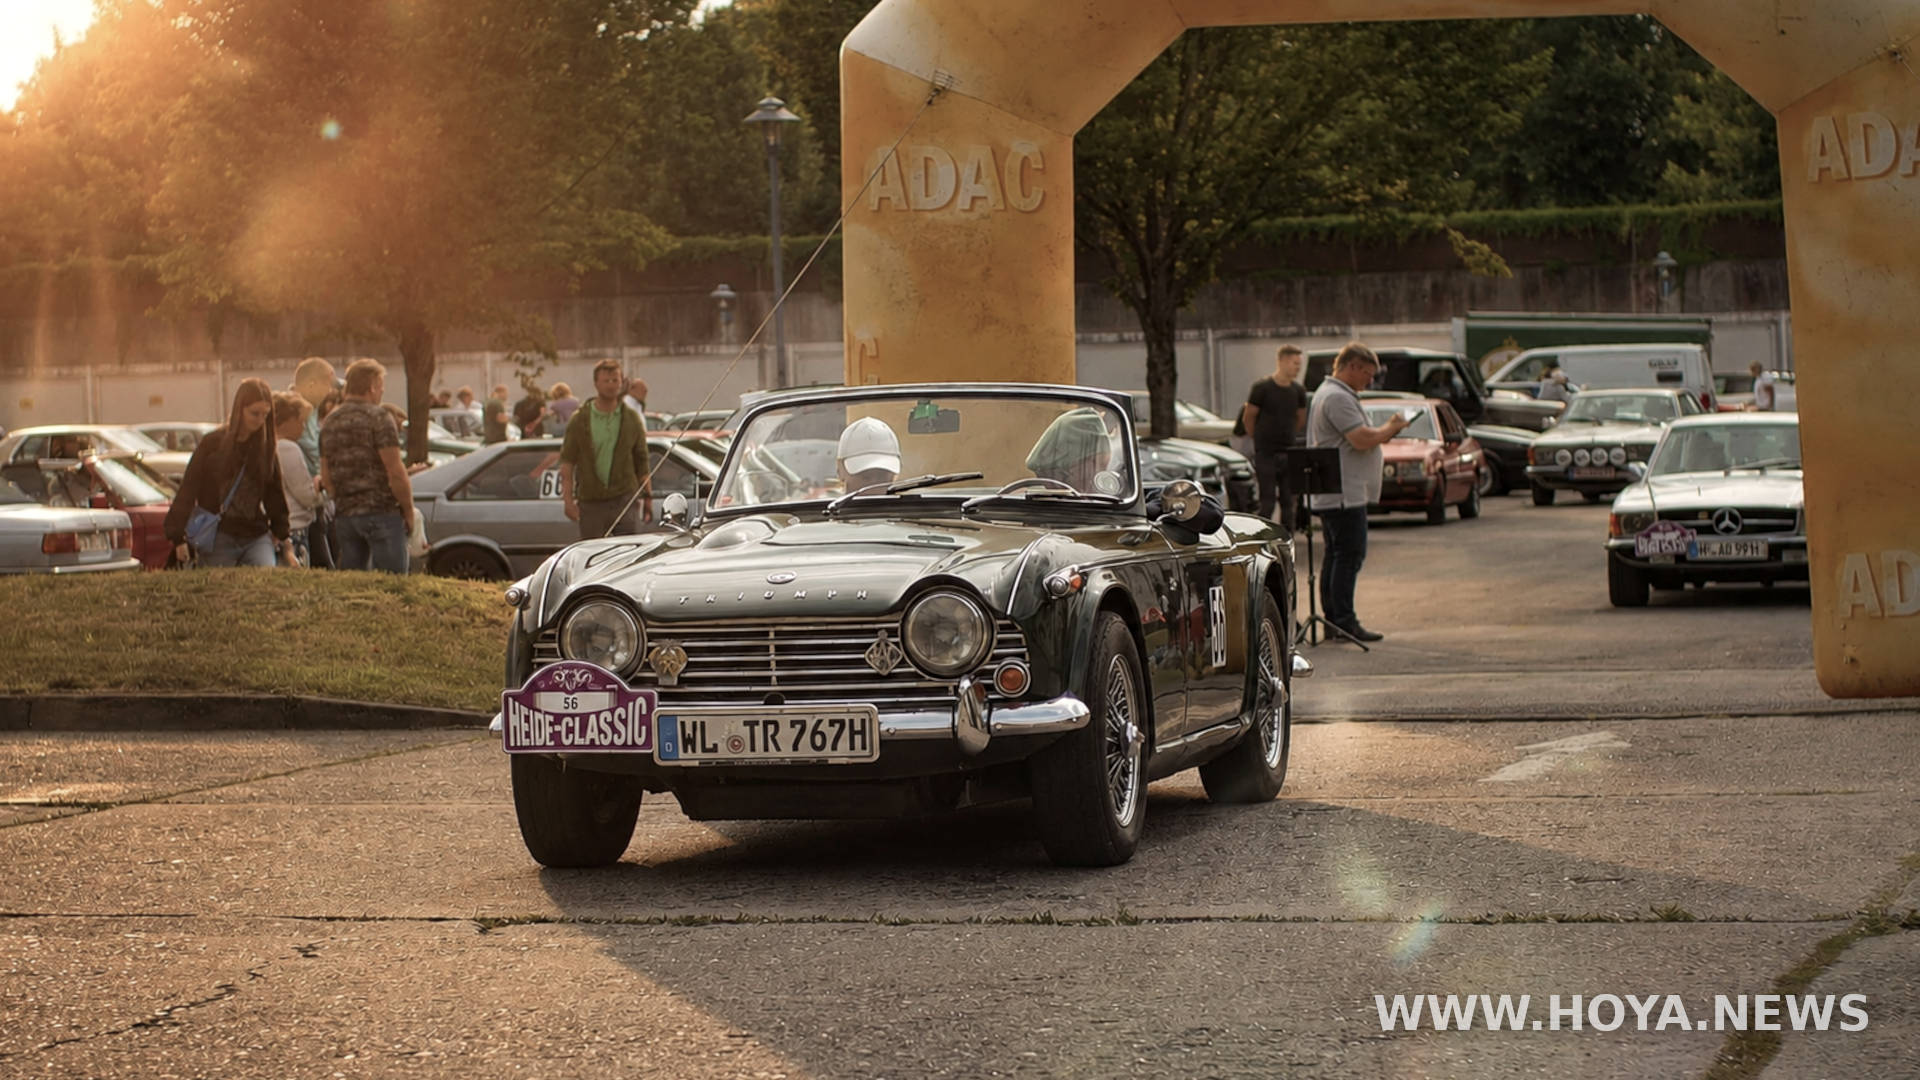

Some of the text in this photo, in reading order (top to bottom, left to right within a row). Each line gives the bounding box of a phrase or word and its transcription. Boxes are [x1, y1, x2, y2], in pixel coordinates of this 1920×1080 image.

[869, 141, 1046, 213] ADAC
[679, 590, 869, 605] TRIUMPH
[1838, 550, 1920, 618] AD
[507, 696, 647, 747] HEIDE-CLASSIC
[563, 697, 578, 709] 56
[679, 718, 867, 753] WL TR 767H
